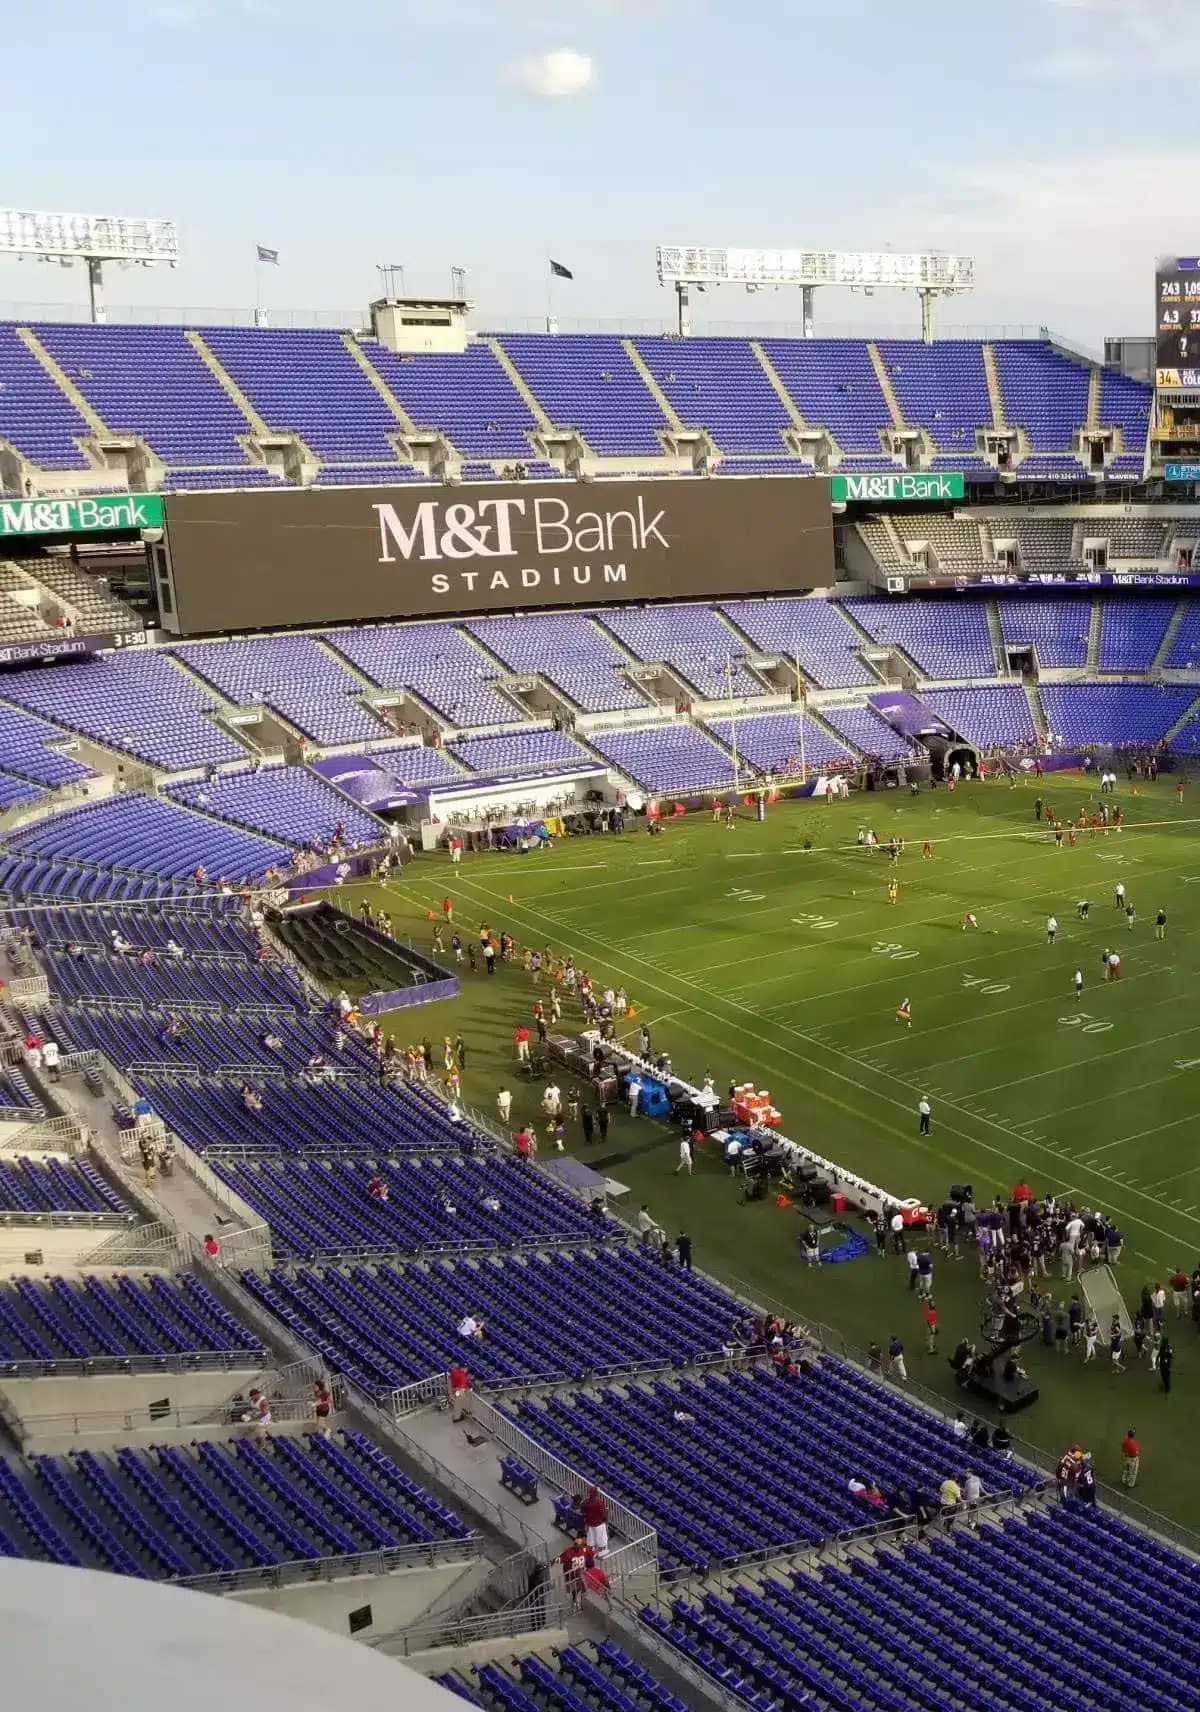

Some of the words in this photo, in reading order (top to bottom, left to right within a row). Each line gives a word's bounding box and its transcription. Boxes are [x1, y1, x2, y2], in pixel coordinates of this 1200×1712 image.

[1161, 282, 1180, 296] 243
[1180, 337, 1187, 351] 7
[1159, 370, 1171, 385] 34
[371, 498, 526, 563] M&T
[534, 495, 671, 554] Bank
[431, 563, 628, 593] STADIUM
[1154, 575, 1189, 585] Stadium
[40, 640, 86, 656] Stadium
[1057, 1012, 1115, 1033] 50
